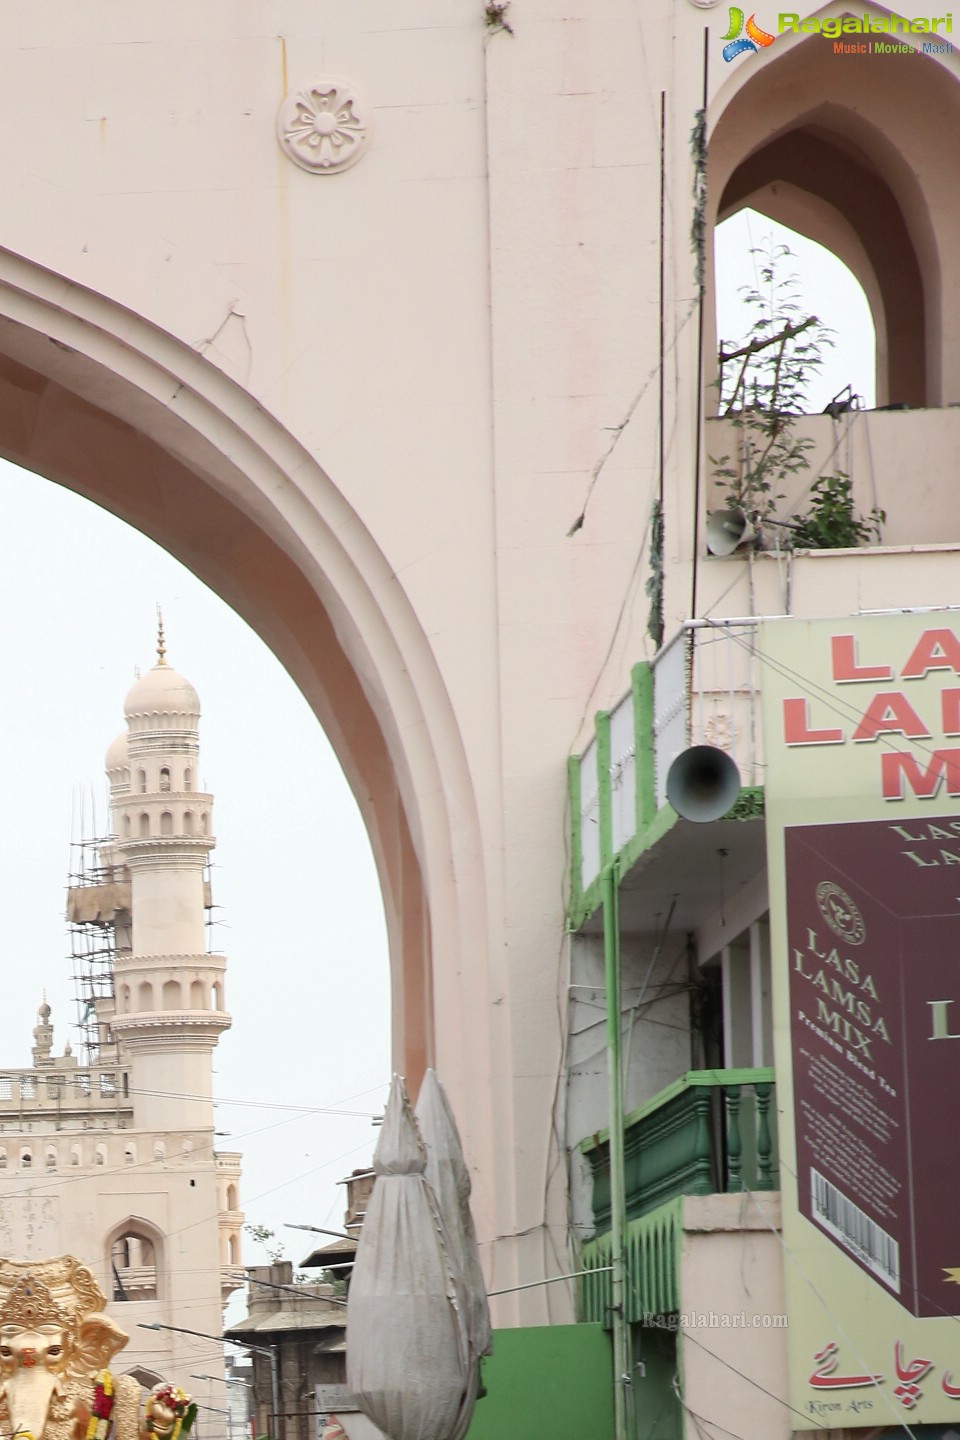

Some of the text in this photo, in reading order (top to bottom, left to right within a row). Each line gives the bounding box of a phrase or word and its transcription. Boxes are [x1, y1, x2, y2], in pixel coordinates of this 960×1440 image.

[793, 948, 894, 1045] LAMSA
[806, 927, 881, 1003] LASA
[816, 997, 875, 1062] MIX
